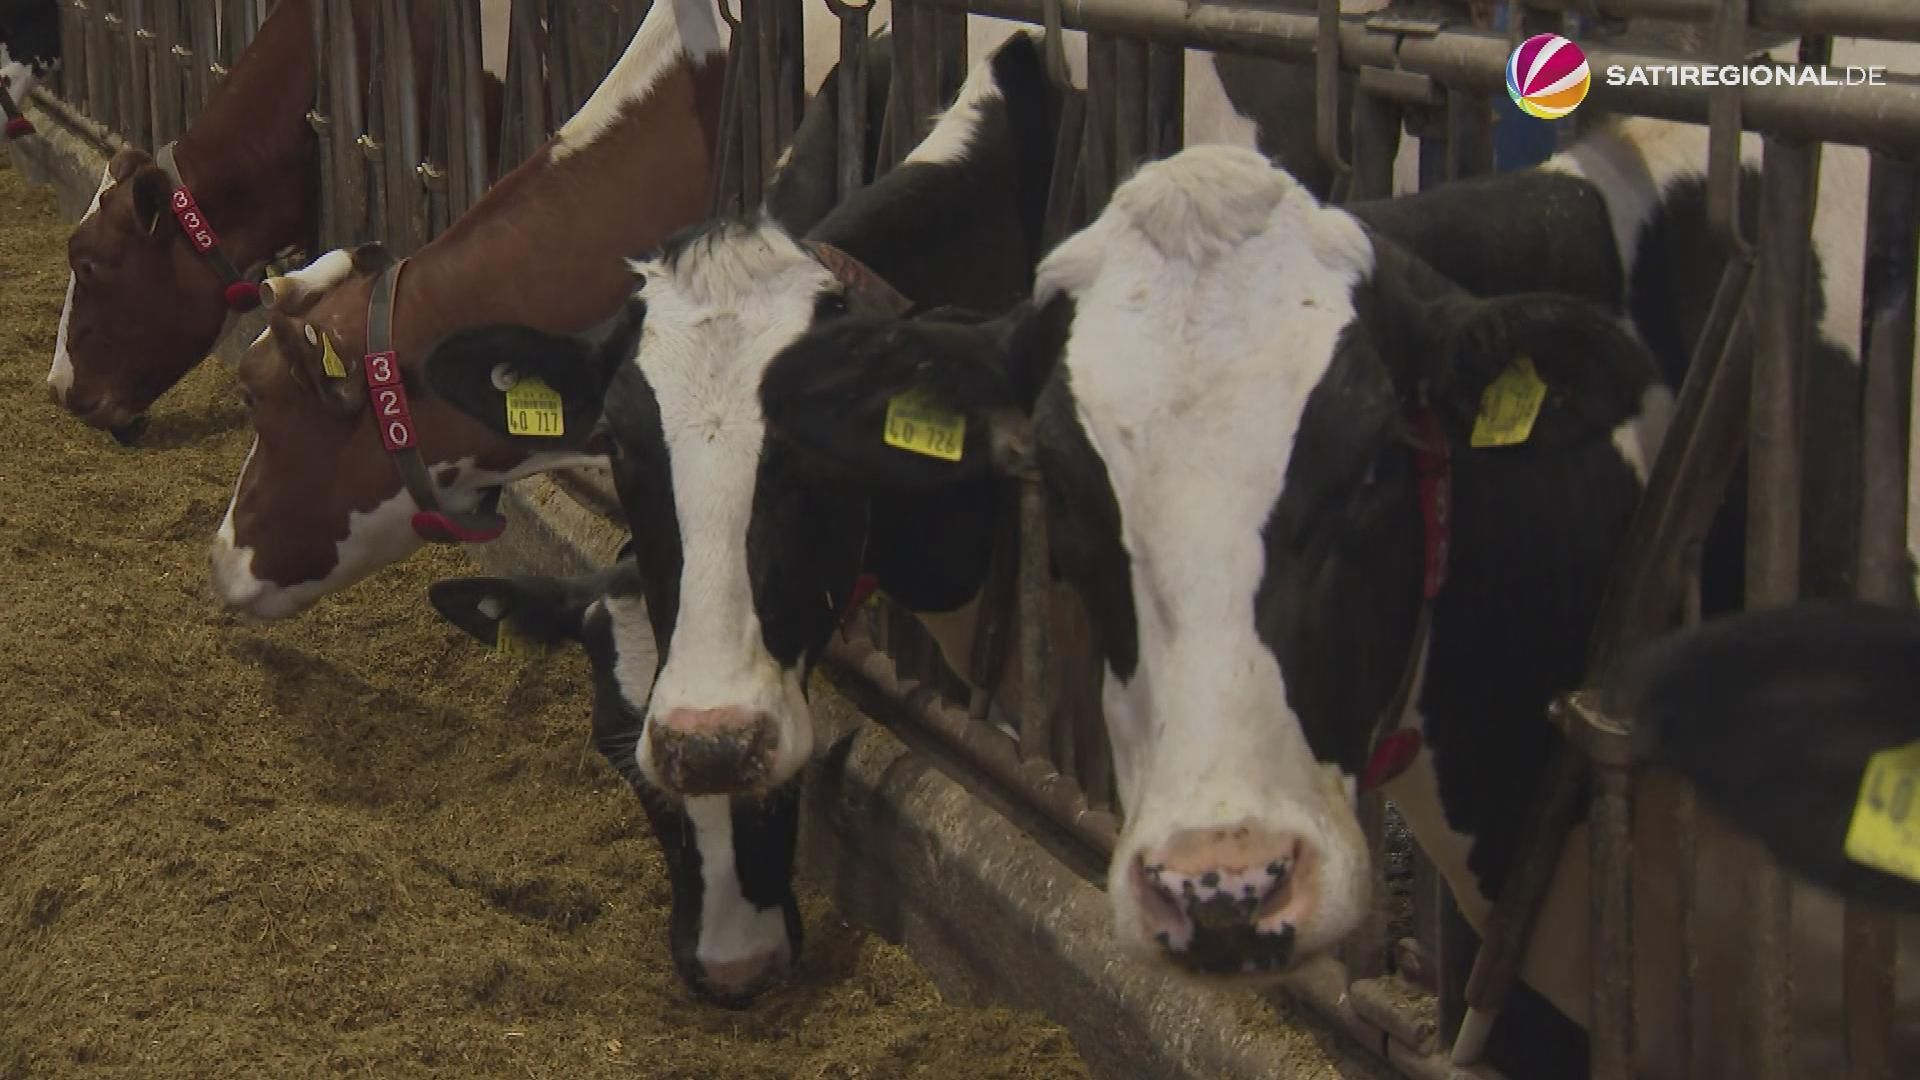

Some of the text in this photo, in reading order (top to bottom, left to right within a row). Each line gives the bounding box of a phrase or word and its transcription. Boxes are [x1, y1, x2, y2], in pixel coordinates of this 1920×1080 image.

[173, 190, 212, 247] 335
[372, 357, 408, 446] 320
[510, 409, 558, 432] 40 717
[888, 417, 915, 443] 40
